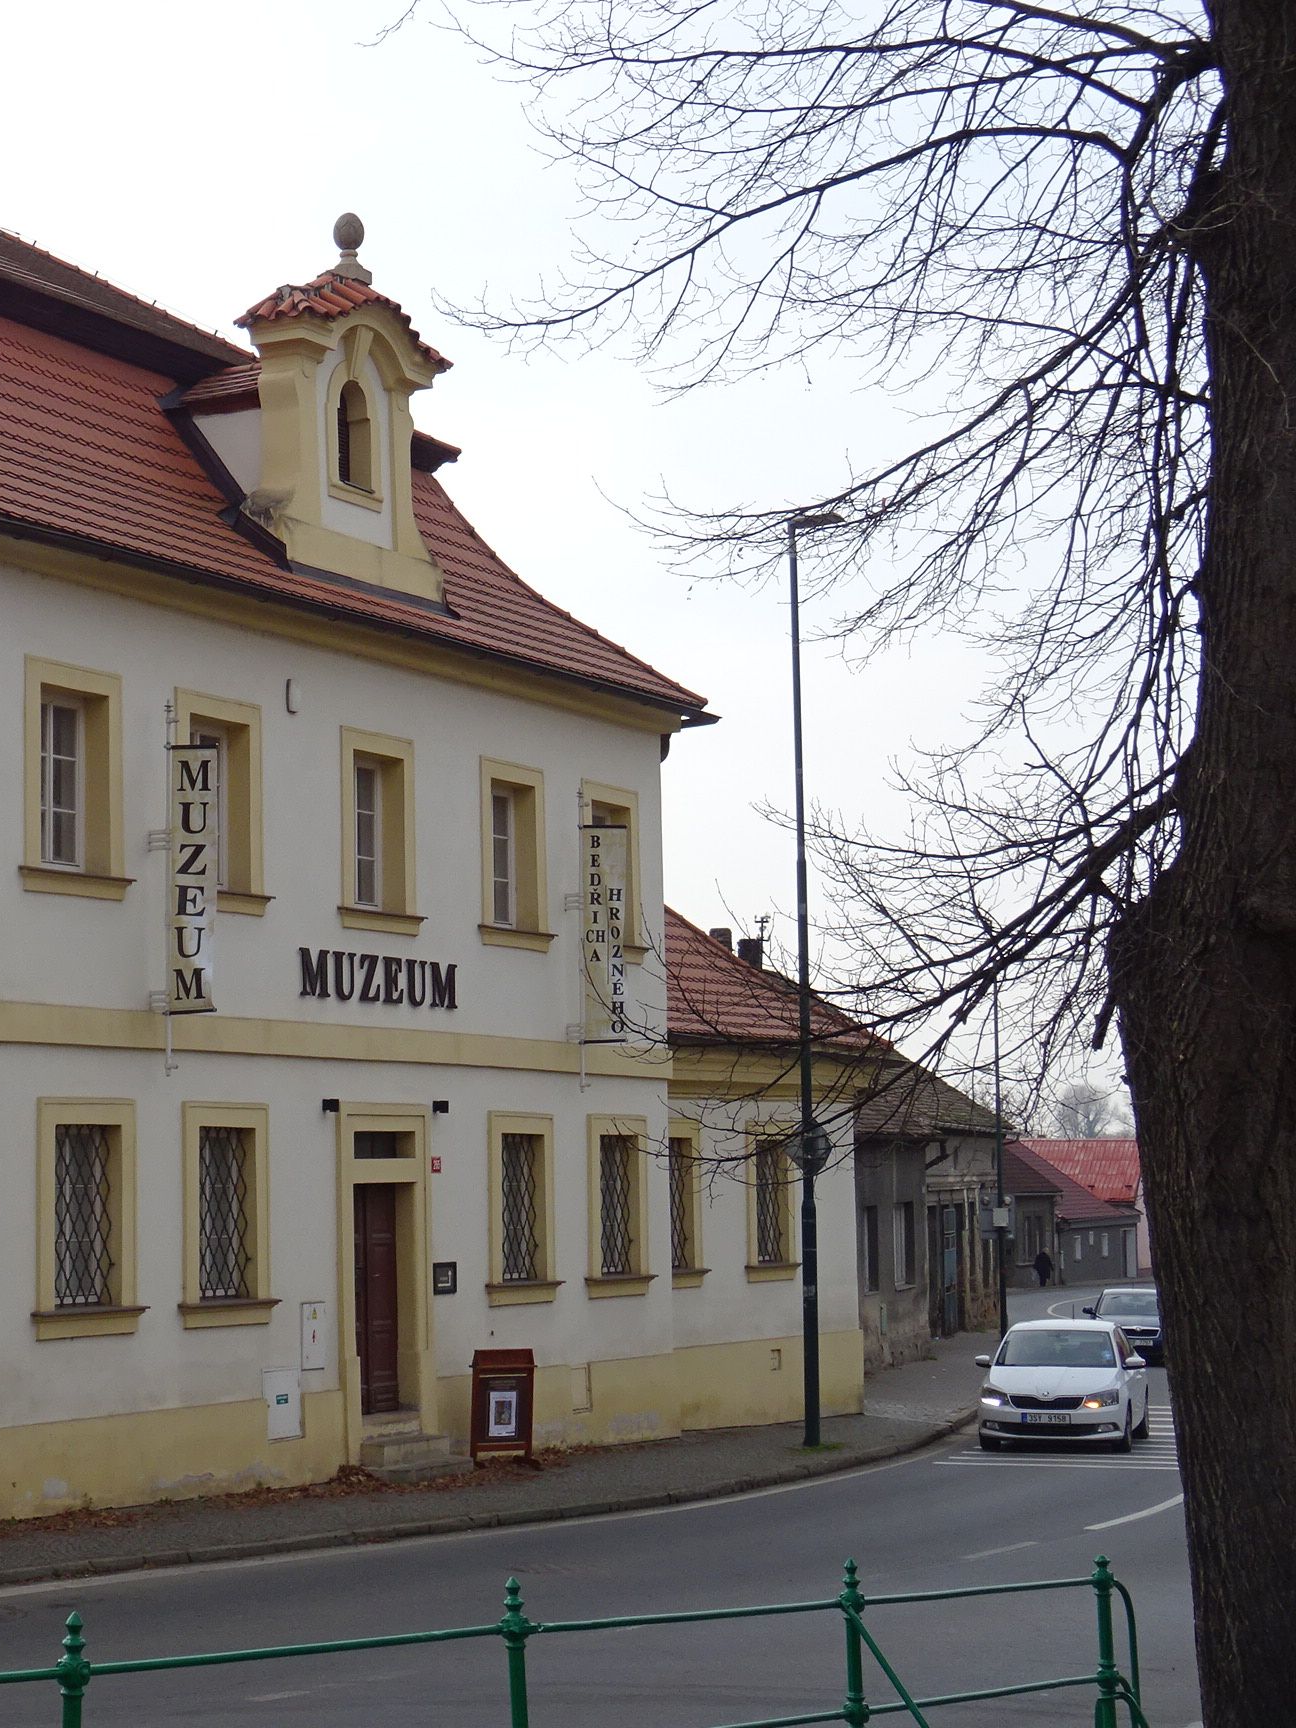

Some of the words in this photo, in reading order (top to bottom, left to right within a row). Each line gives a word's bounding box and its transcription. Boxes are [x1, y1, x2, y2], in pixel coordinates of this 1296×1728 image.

[174, 759, 211, 1001] MUZEUM
[585, 835, 606, 963] BEDŘICHA
[298, 947, 458, 1009] MUZEUM
[608, 887, 625, 1035] HROZNÉHO
[1047, 1414, 1067, 1423] 9158
